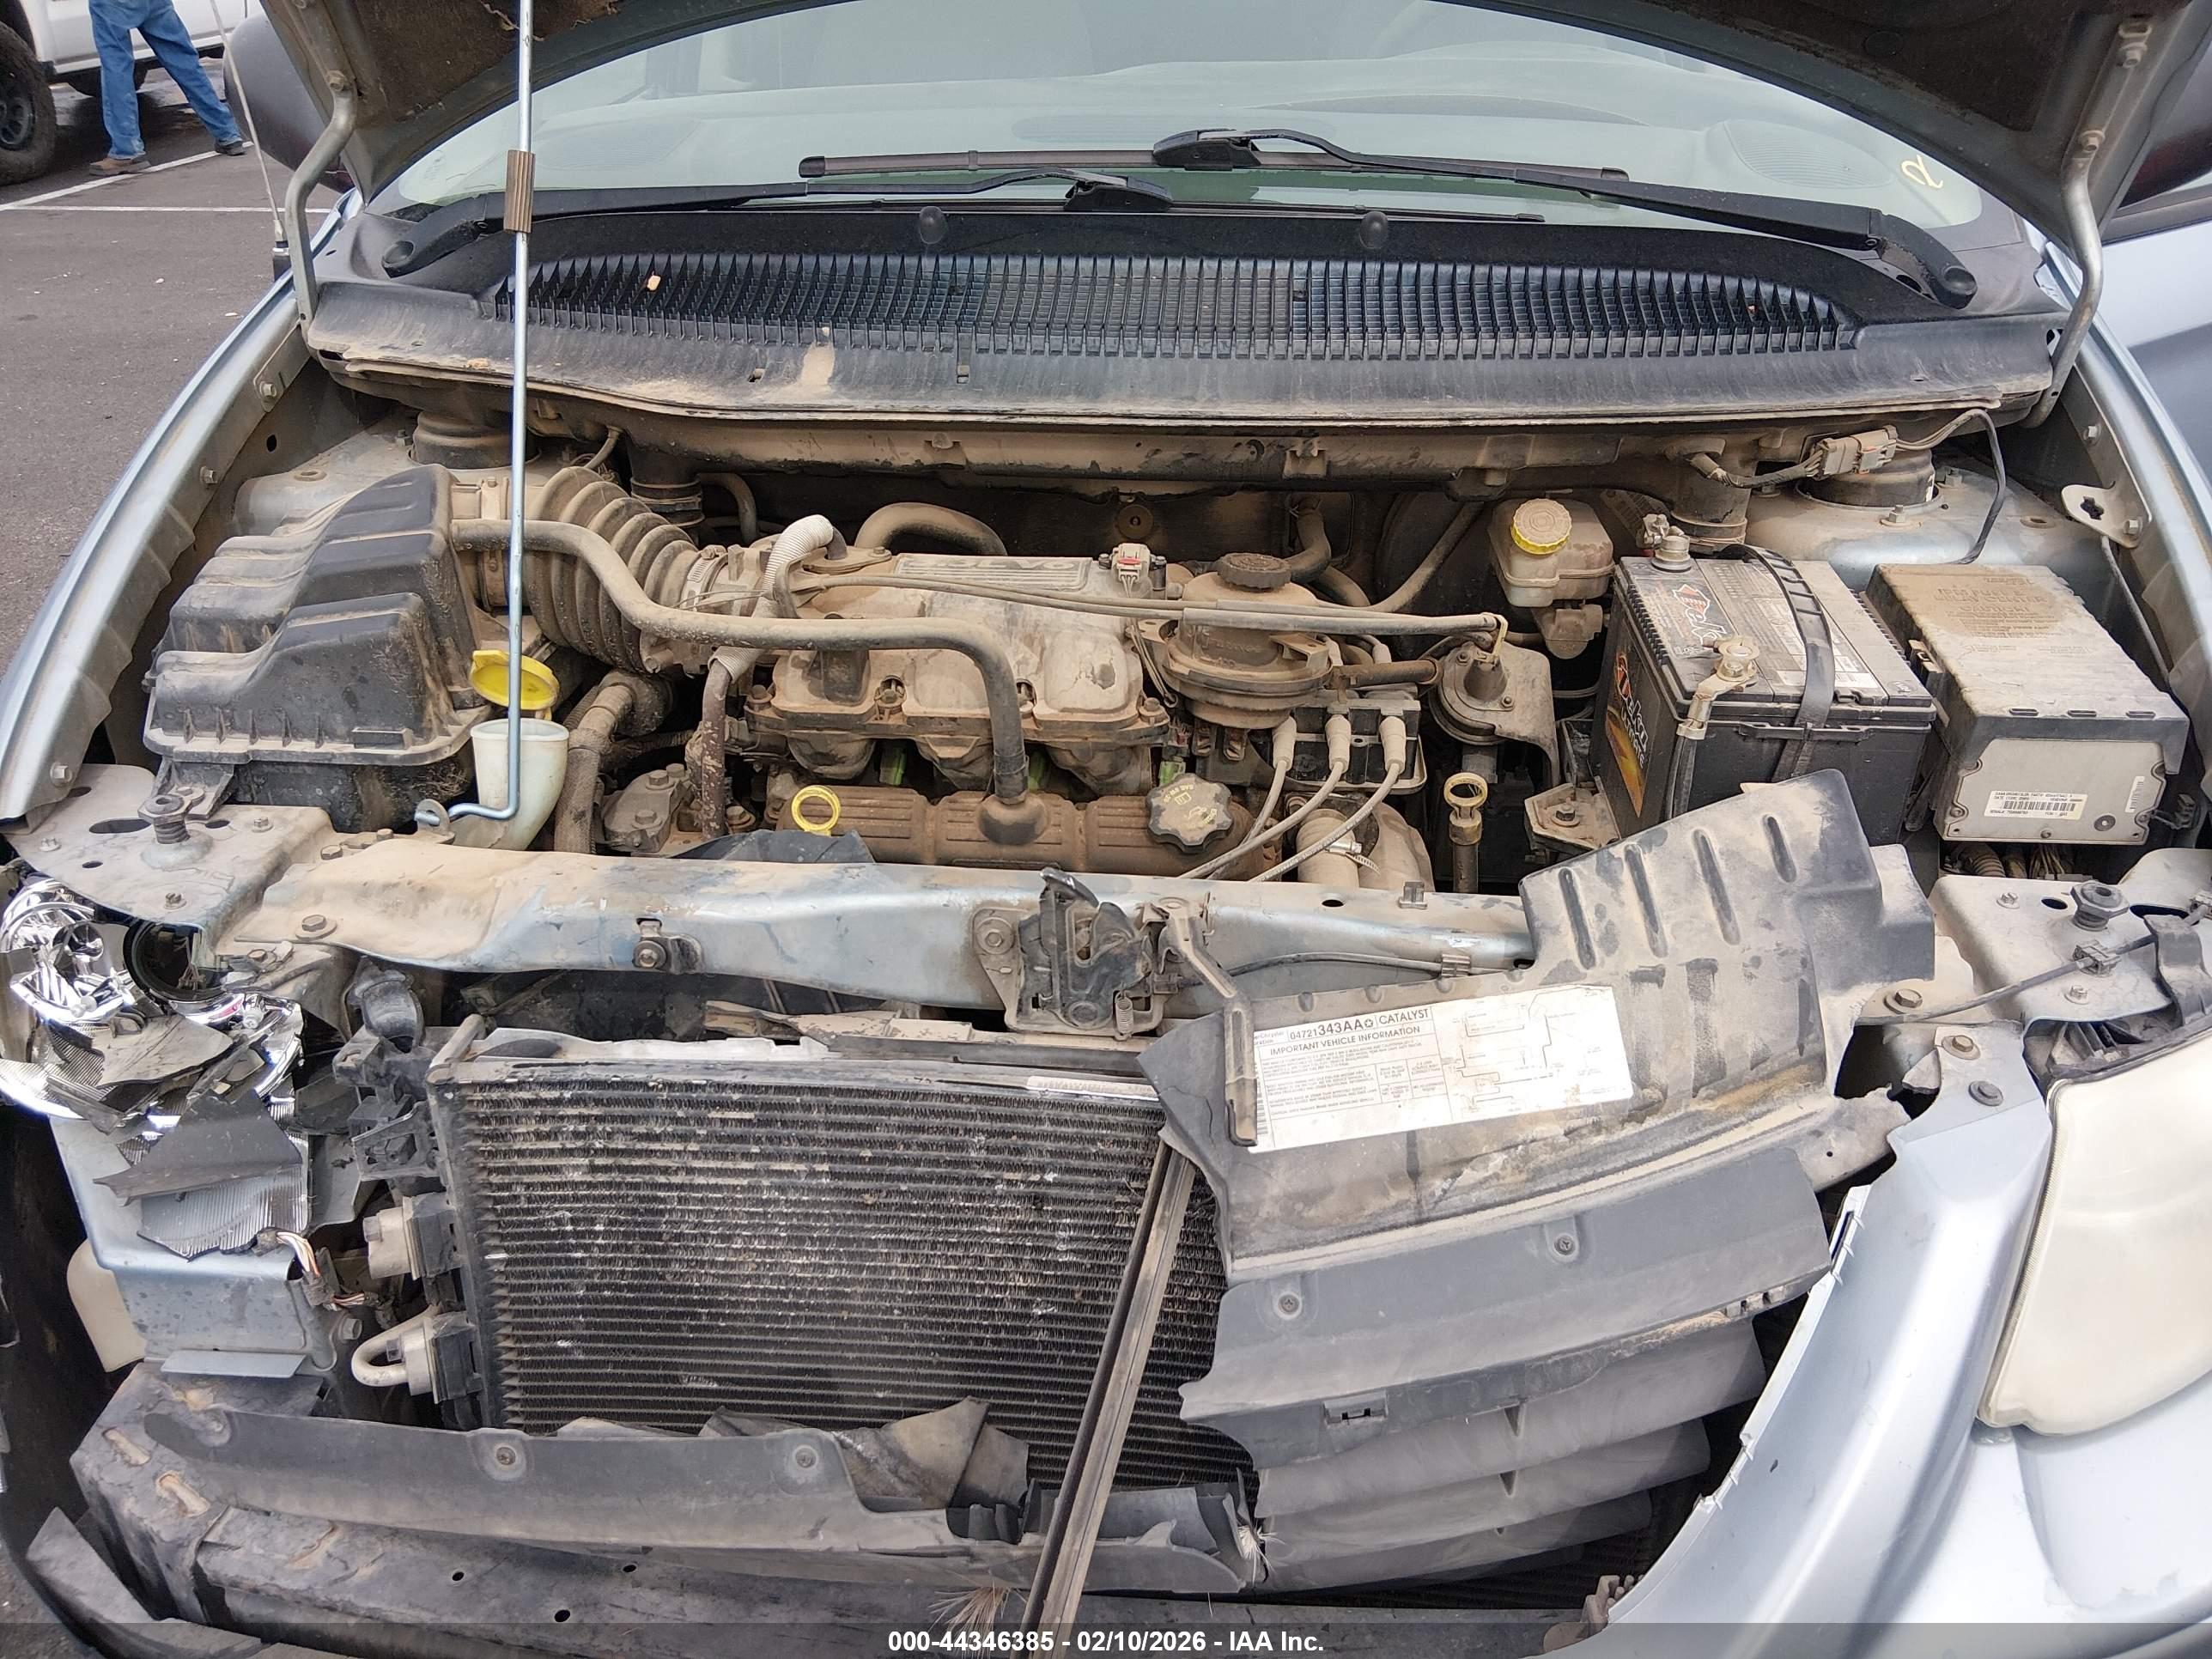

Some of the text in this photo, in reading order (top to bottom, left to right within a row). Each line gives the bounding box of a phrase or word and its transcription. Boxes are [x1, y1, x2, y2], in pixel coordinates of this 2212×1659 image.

[1290, 1008, 1428, 1040] 04721343AA CATALYST
[1270, 1026, 1420, 1055] IMPORTANT VEHICLE INFORMATION
